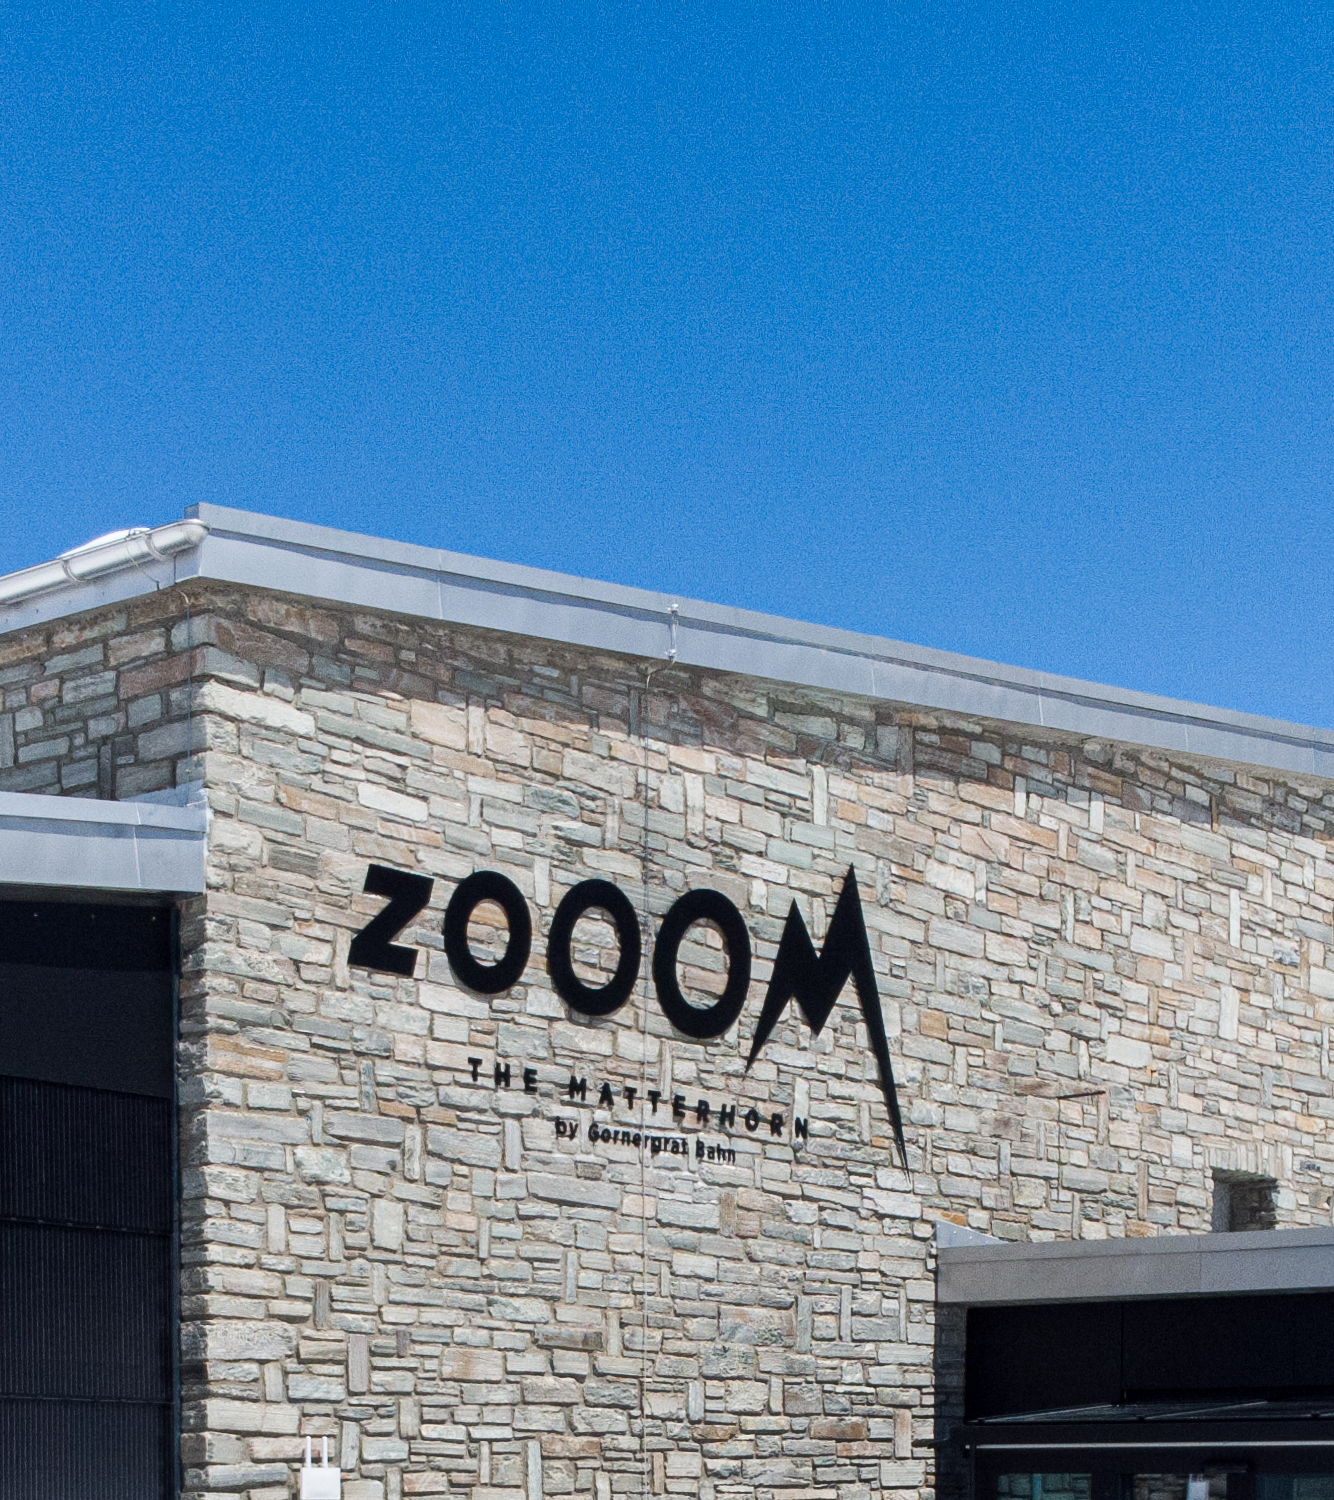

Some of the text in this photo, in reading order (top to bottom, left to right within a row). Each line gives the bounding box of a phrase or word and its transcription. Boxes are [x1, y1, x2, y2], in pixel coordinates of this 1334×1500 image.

[347, 863, 910, 1183] ZOOOM
[467, 1057, 808, 1139] THE MATTERHORN
[554, 1116, 736, 1164] by Gornergrat Bahn
